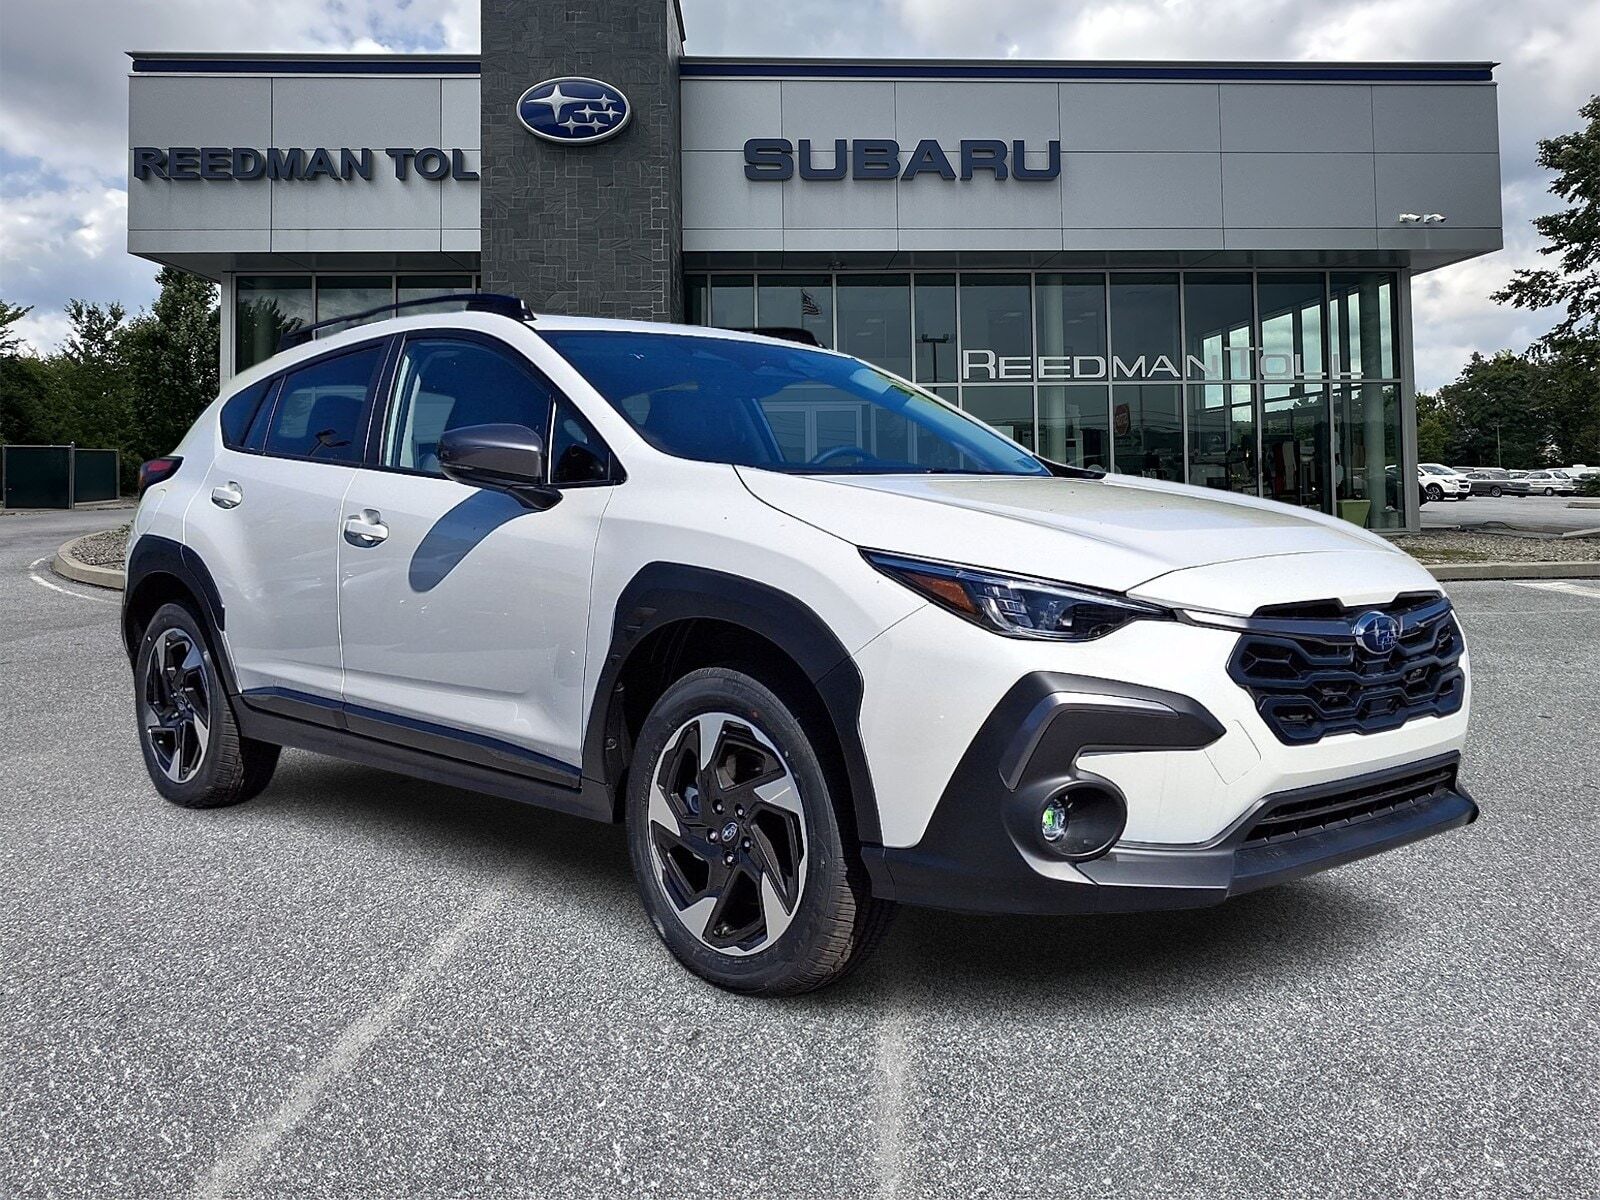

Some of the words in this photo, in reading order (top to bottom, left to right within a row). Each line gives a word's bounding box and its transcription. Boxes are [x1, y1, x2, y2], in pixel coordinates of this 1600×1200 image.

[133, 147, 373, 181] REEDMAN
[386, 148, 480, 181] TOL
[744, 138, 1061, 181] SUBARU
